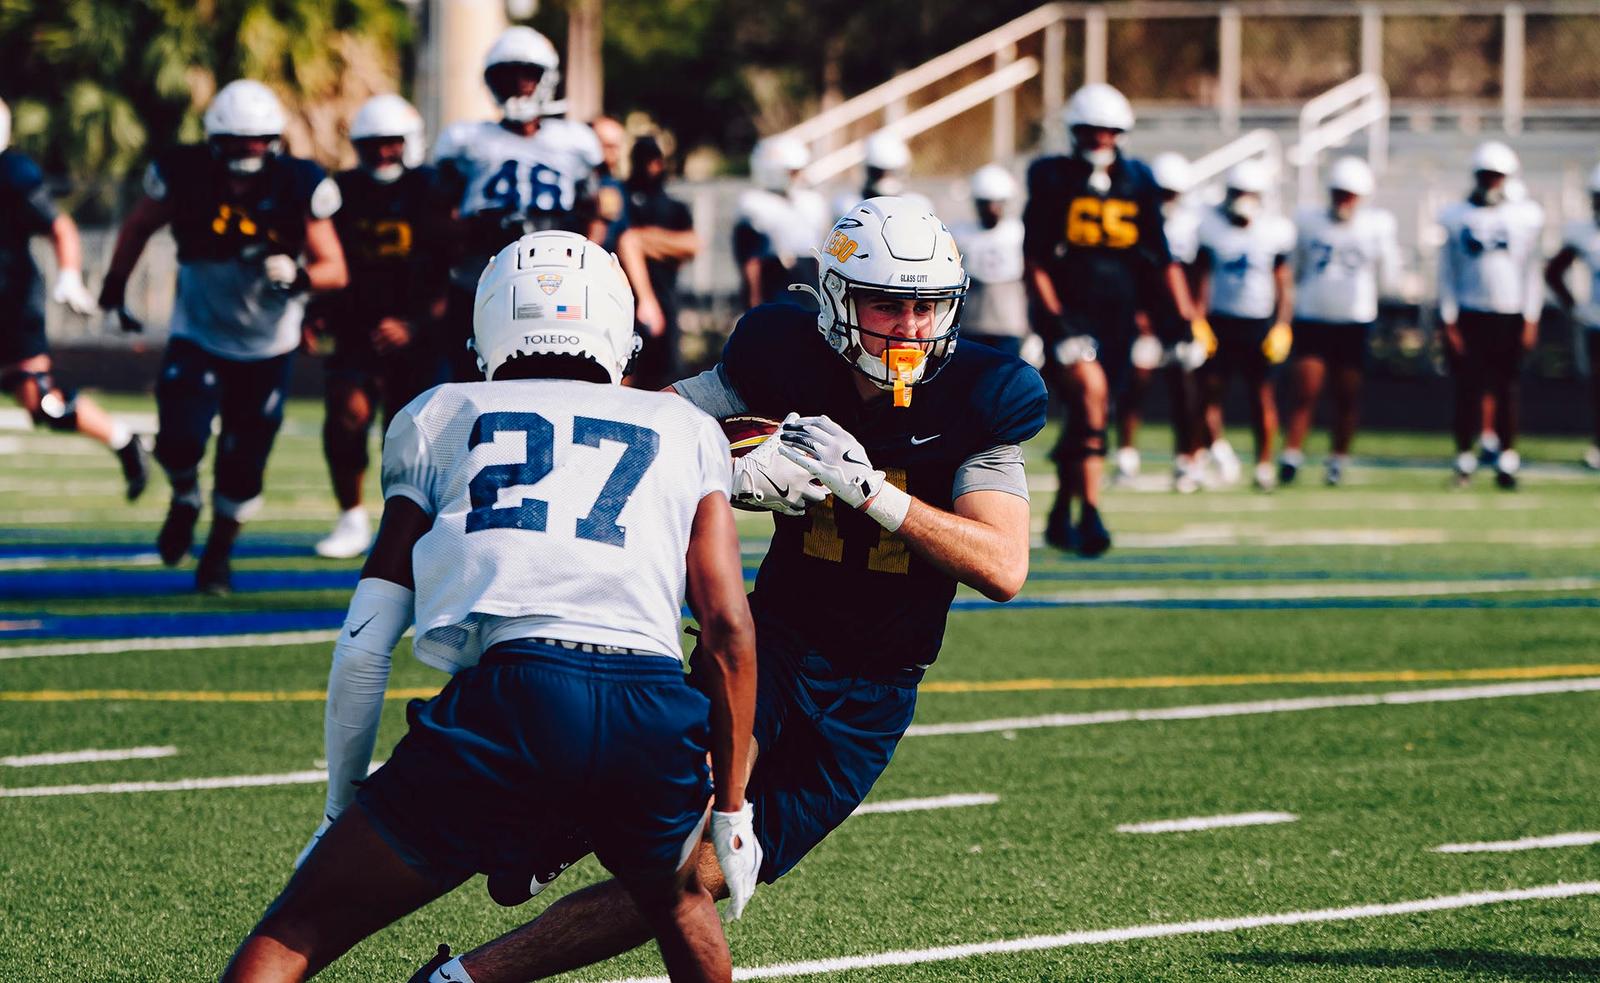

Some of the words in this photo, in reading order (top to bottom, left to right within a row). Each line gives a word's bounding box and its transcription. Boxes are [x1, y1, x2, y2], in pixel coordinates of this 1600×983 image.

[1067, 196, 1138, 248] 65
[900, 274, 916, 283] GLASS
[917, 274, 928, 283] CITY
[524, 335, 580, 345] TOLEDO
[465, 411, 660, 548] 27
